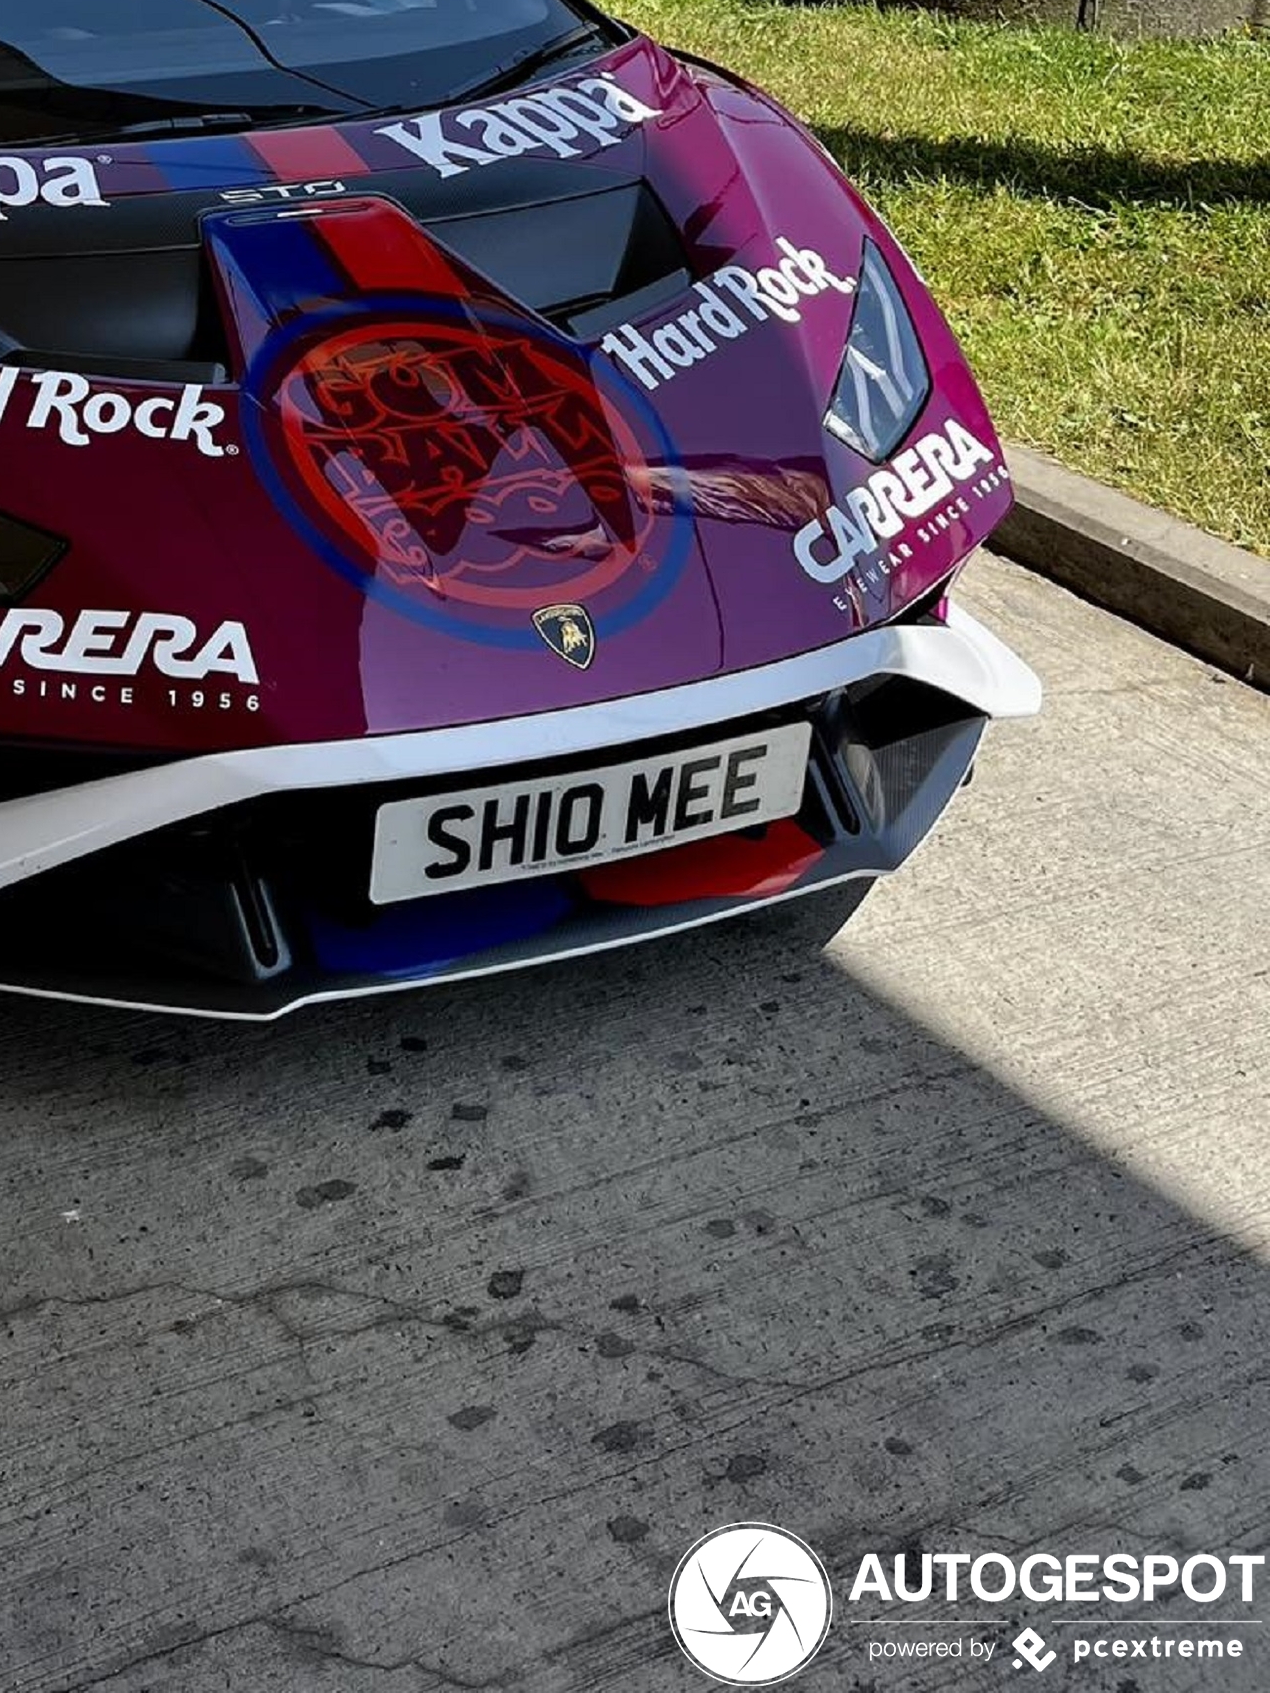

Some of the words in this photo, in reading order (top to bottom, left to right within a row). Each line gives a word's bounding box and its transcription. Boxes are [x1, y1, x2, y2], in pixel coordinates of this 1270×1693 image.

[373, 76, 664, 180] Kappa
[219, 179, 347, 205] STO
[601, 281, 748, 390] Hard
[714, 236, 852, 323] Rock
[28, 370, 226, 457] Rock
[793, 418, 995, 583] CARRERA
[833, 543, 914, 611] EYEWEAR
[917, 497, 970, 543] SINCE
[972, 465, 1009, 499] 1956
[13, 678, 133, 704] SINCE
[168, 688, 261, 712] 1956
[624, 743, 769, 844] MEE
